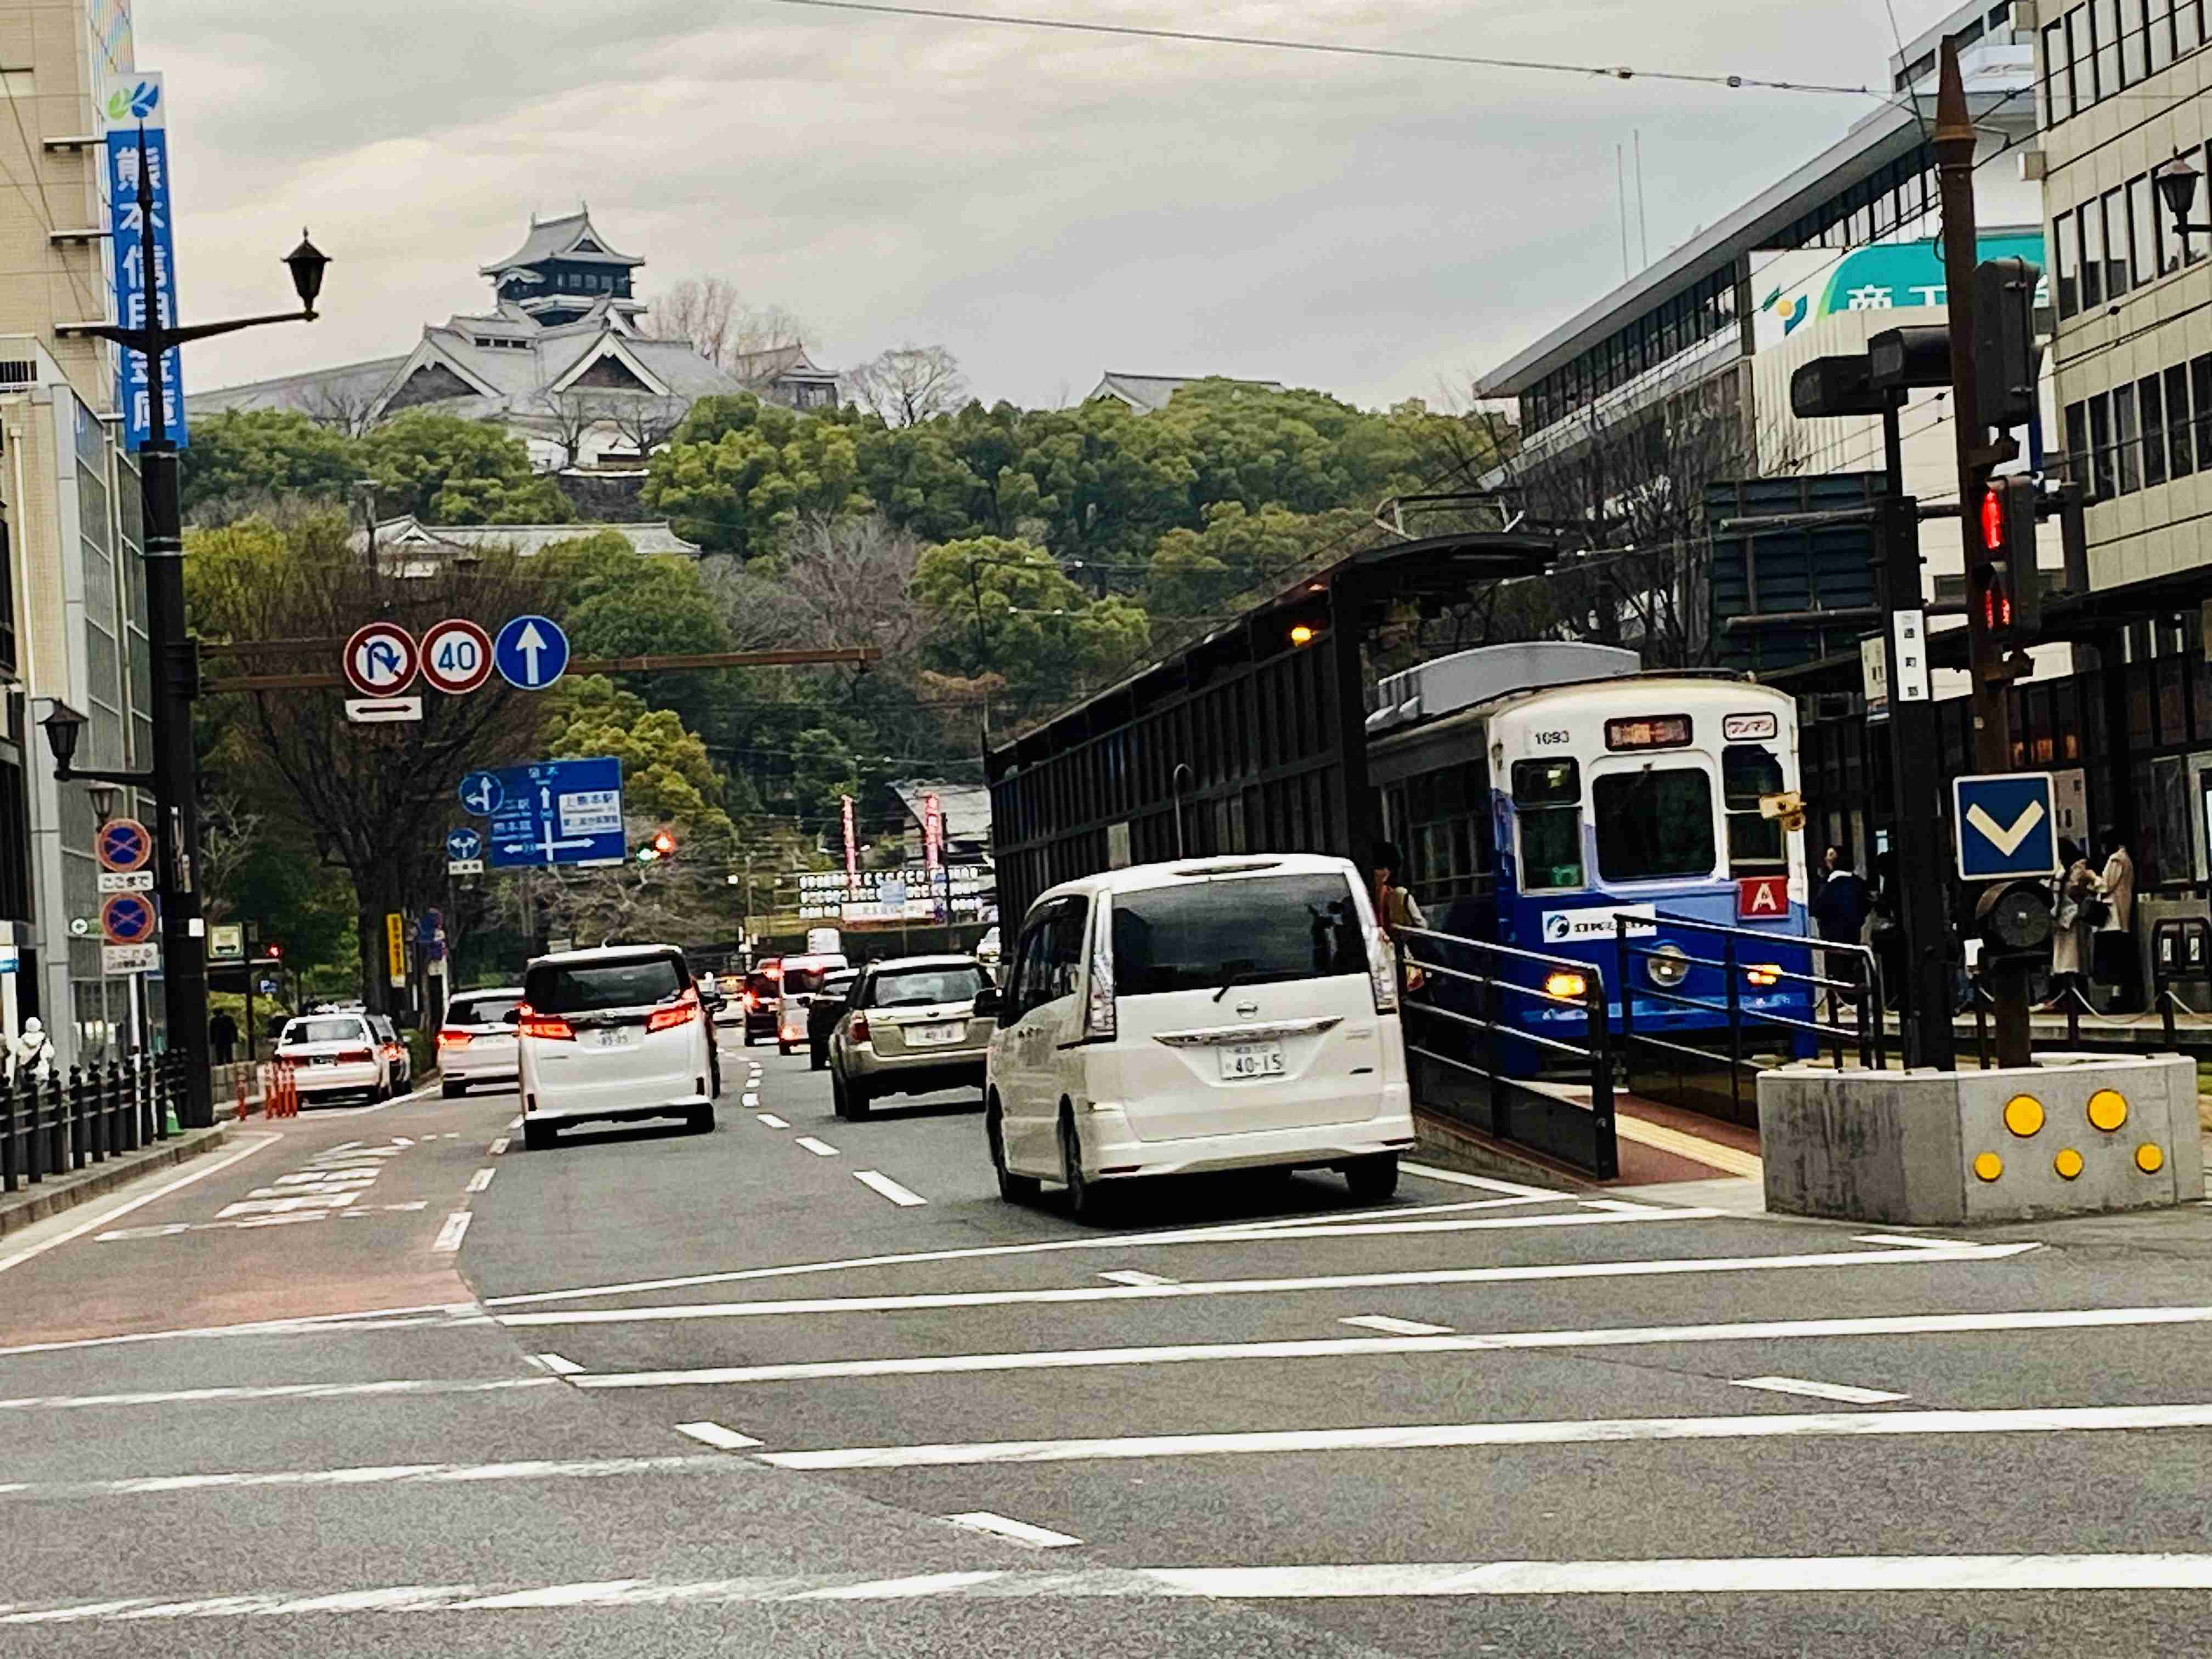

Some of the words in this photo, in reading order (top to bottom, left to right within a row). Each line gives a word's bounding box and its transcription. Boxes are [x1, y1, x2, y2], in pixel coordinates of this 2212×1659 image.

[438, 641, 476, 671] 40
[103, 875, 150, 889] ここまで
[1751, 883, 1777, 912] A
[1236, 1053, 1282, 1074] 40-15
